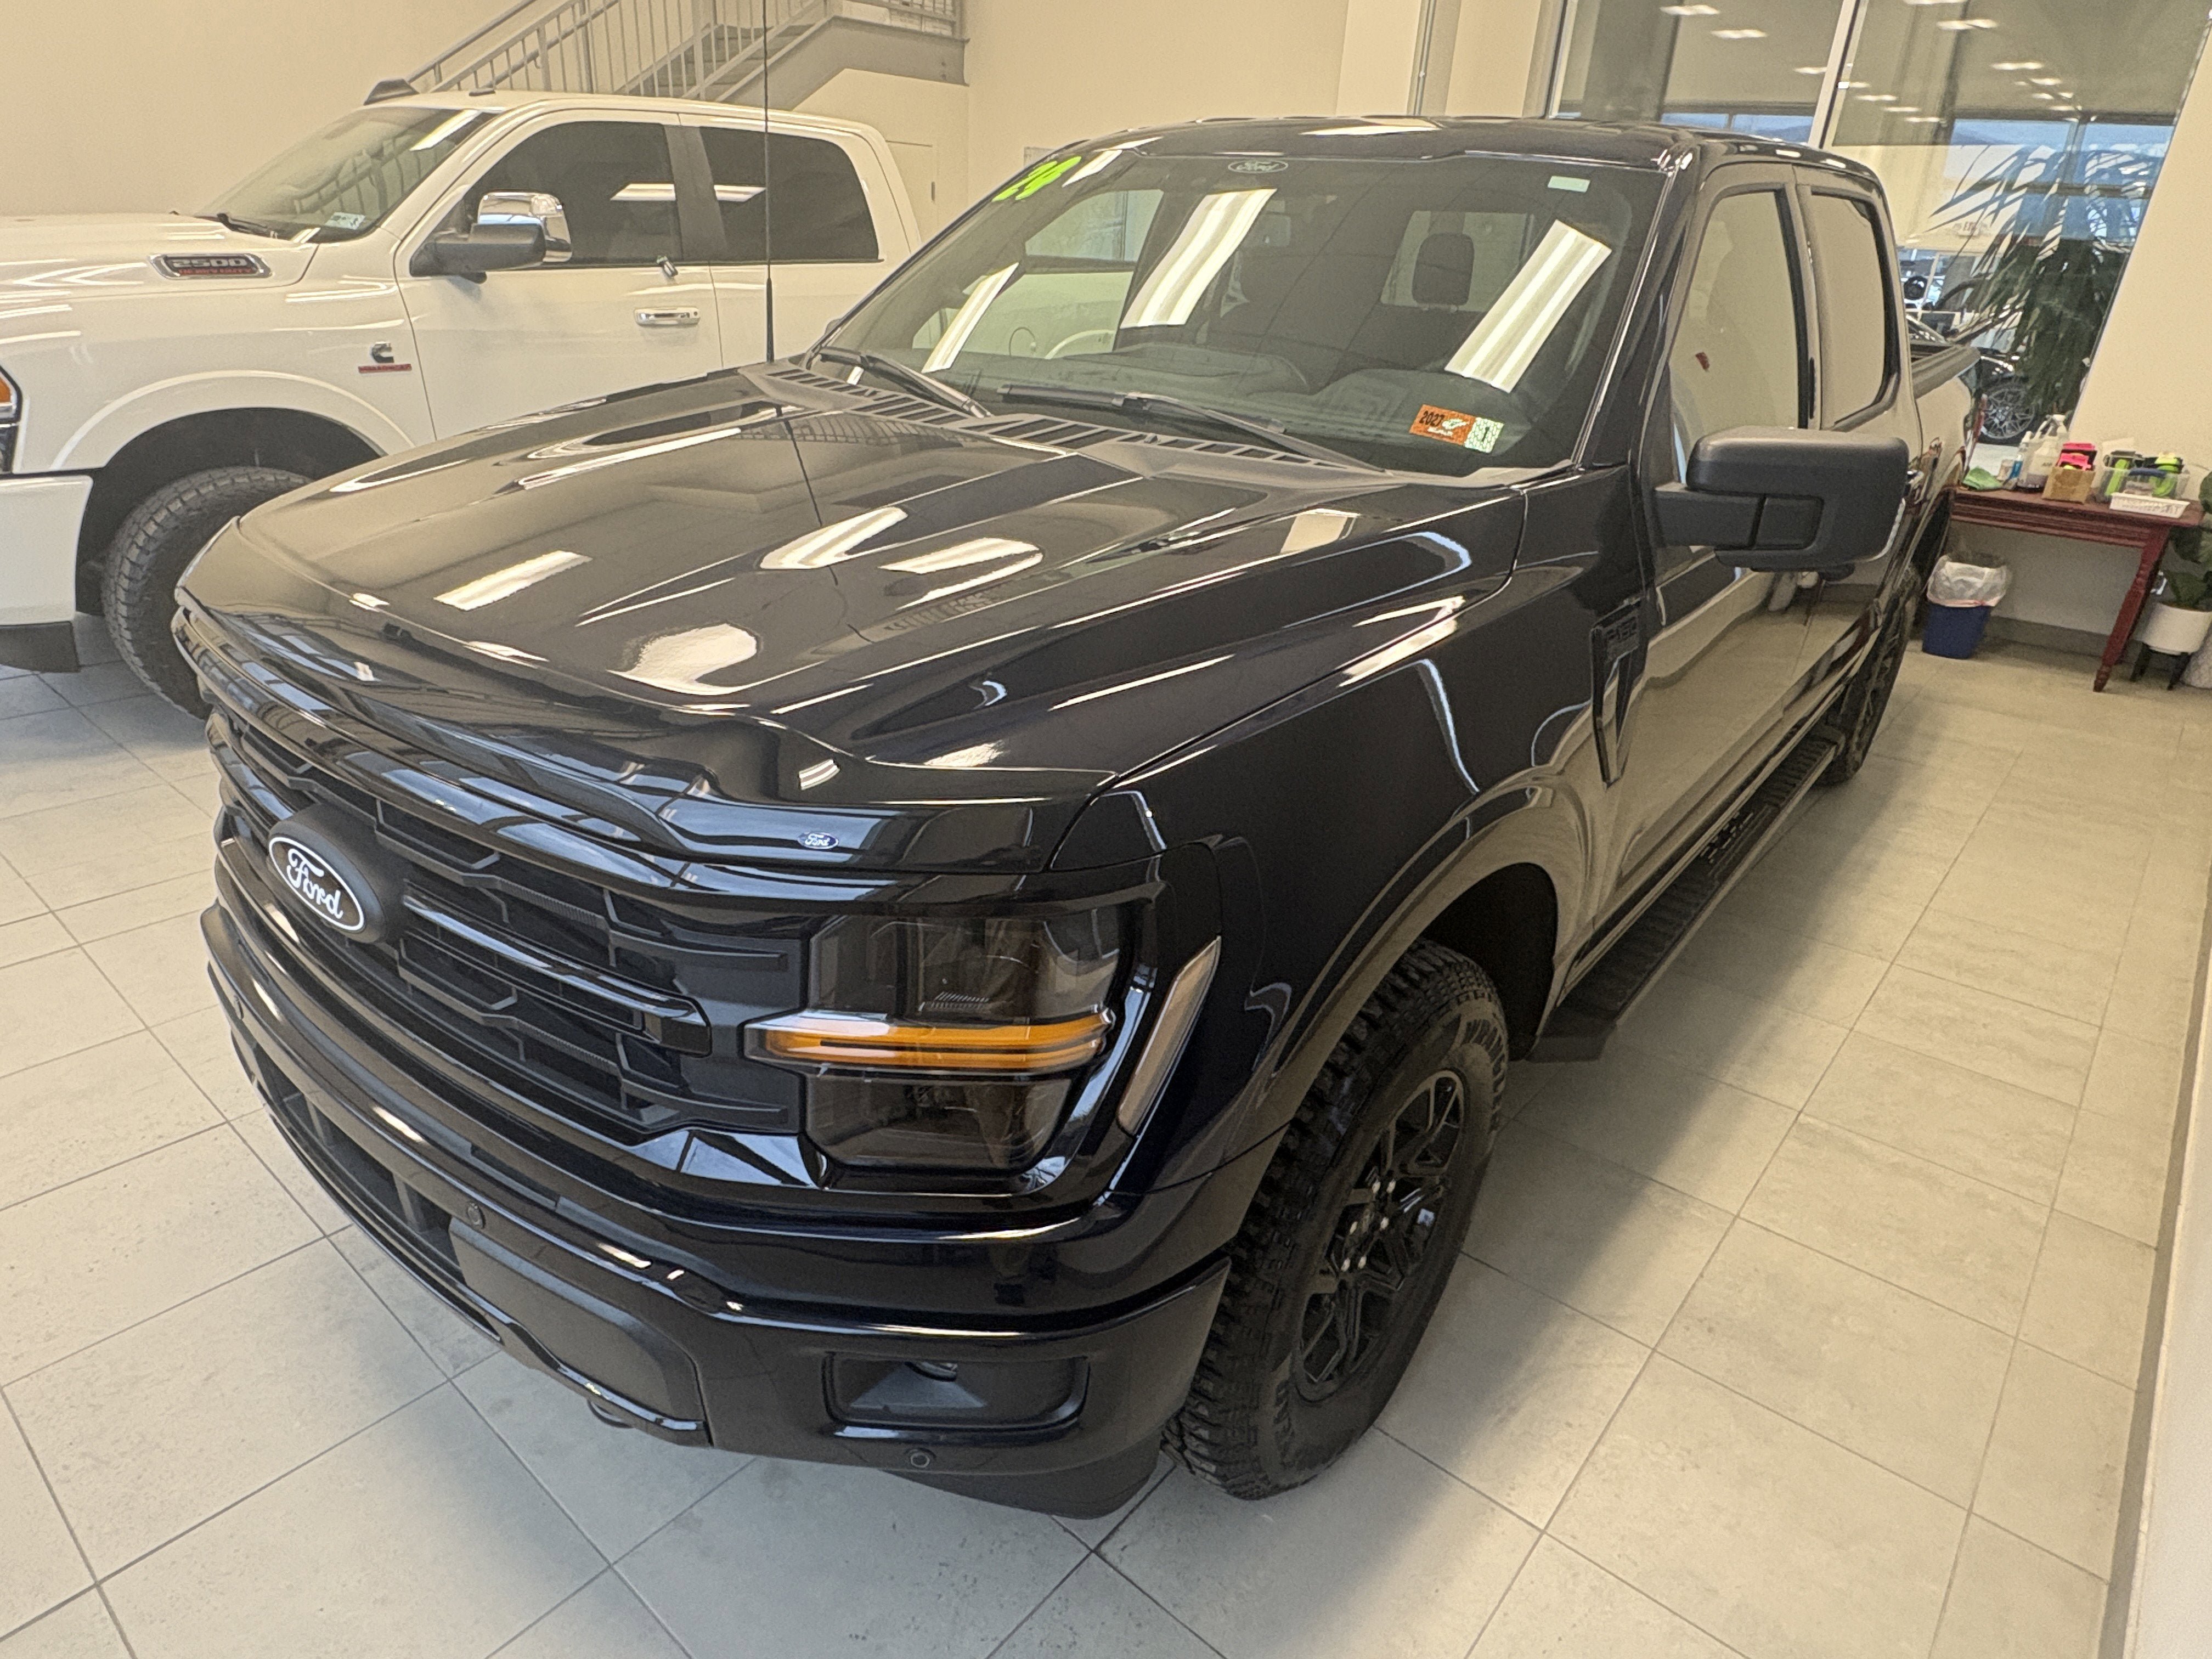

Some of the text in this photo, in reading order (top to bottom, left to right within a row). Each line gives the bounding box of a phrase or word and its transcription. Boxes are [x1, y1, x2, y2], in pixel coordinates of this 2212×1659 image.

[1237, 161, 1279, 171] Ford
[172, 258, 247, 268] 2500
[1419, 410, 1445, 427] 2027
[804, 834, 831, 846] Ford
[286, 848, 344, 919] Ford
